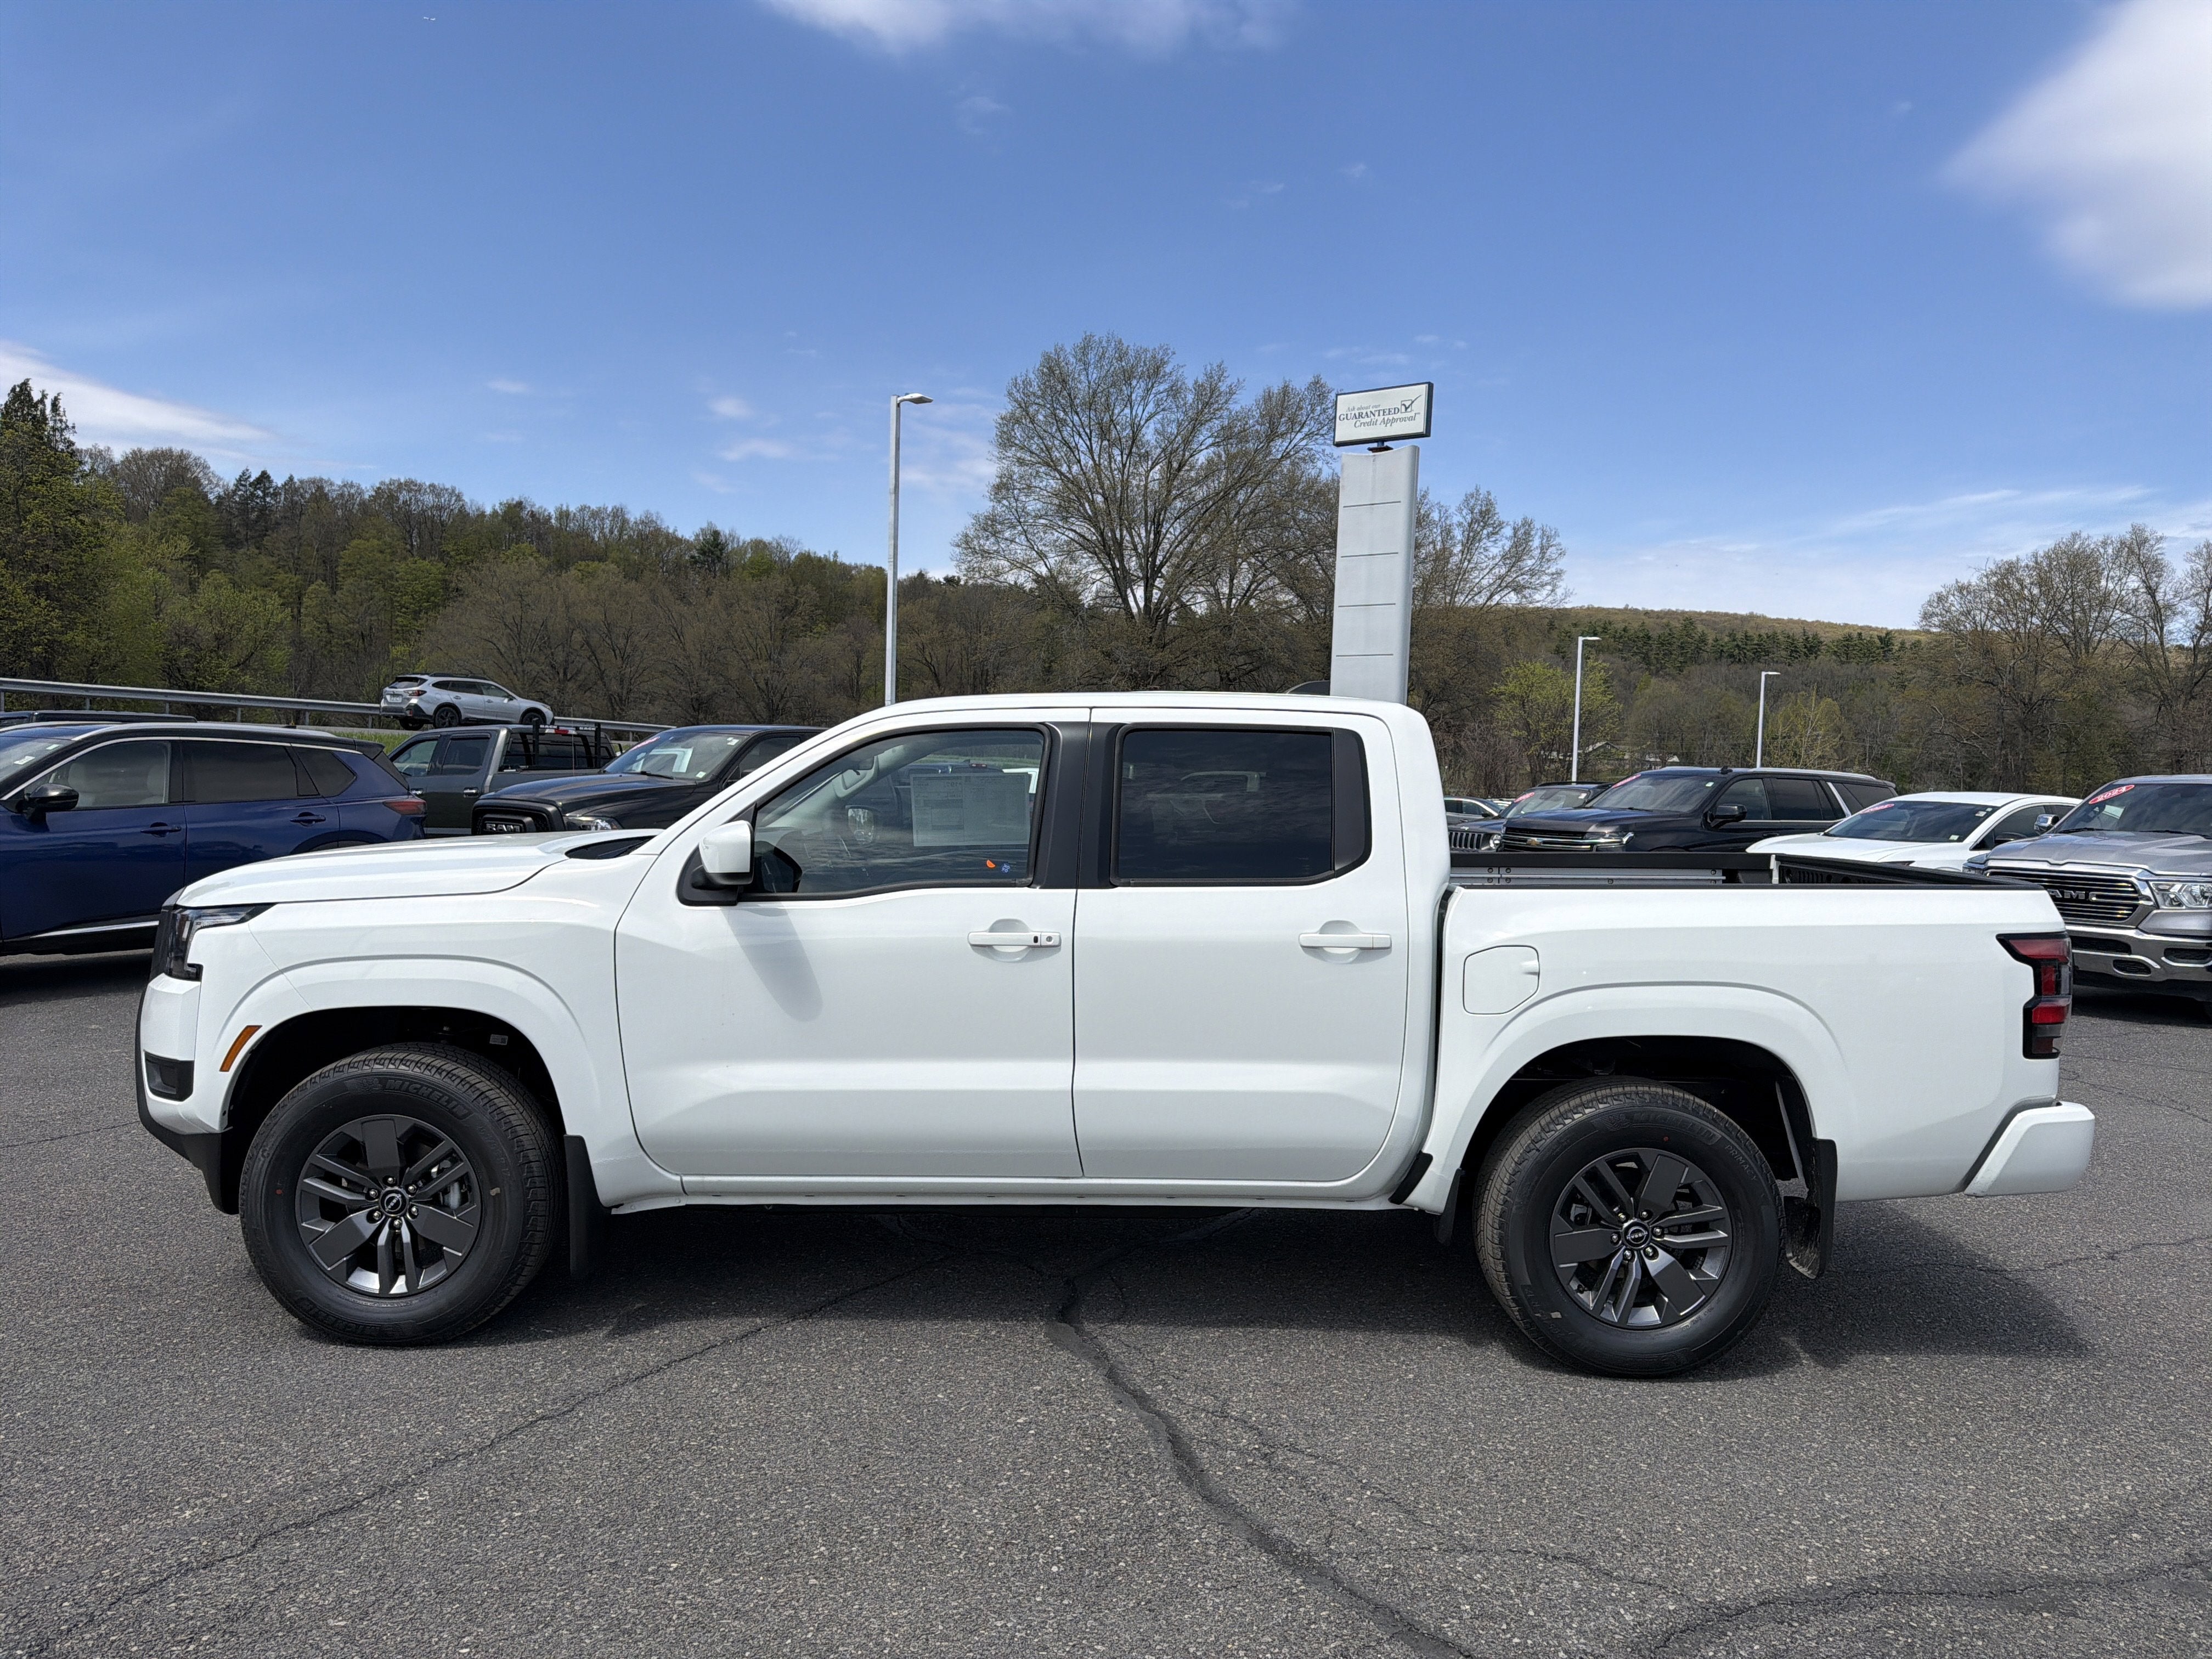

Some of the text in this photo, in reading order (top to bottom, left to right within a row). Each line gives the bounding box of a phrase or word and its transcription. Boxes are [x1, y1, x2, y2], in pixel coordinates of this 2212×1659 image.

[1339, 407, 1400, 421] GUARANTEED
[1354, 413, 1417, 428] Credit Approval
[486, 823, 521, 832] RAM
[2047, 889, 2086, 900] AM
[385, 1079, 470, 1115] MICHELIN
[1724, 1144, 1757, 1181] PRIMACY
